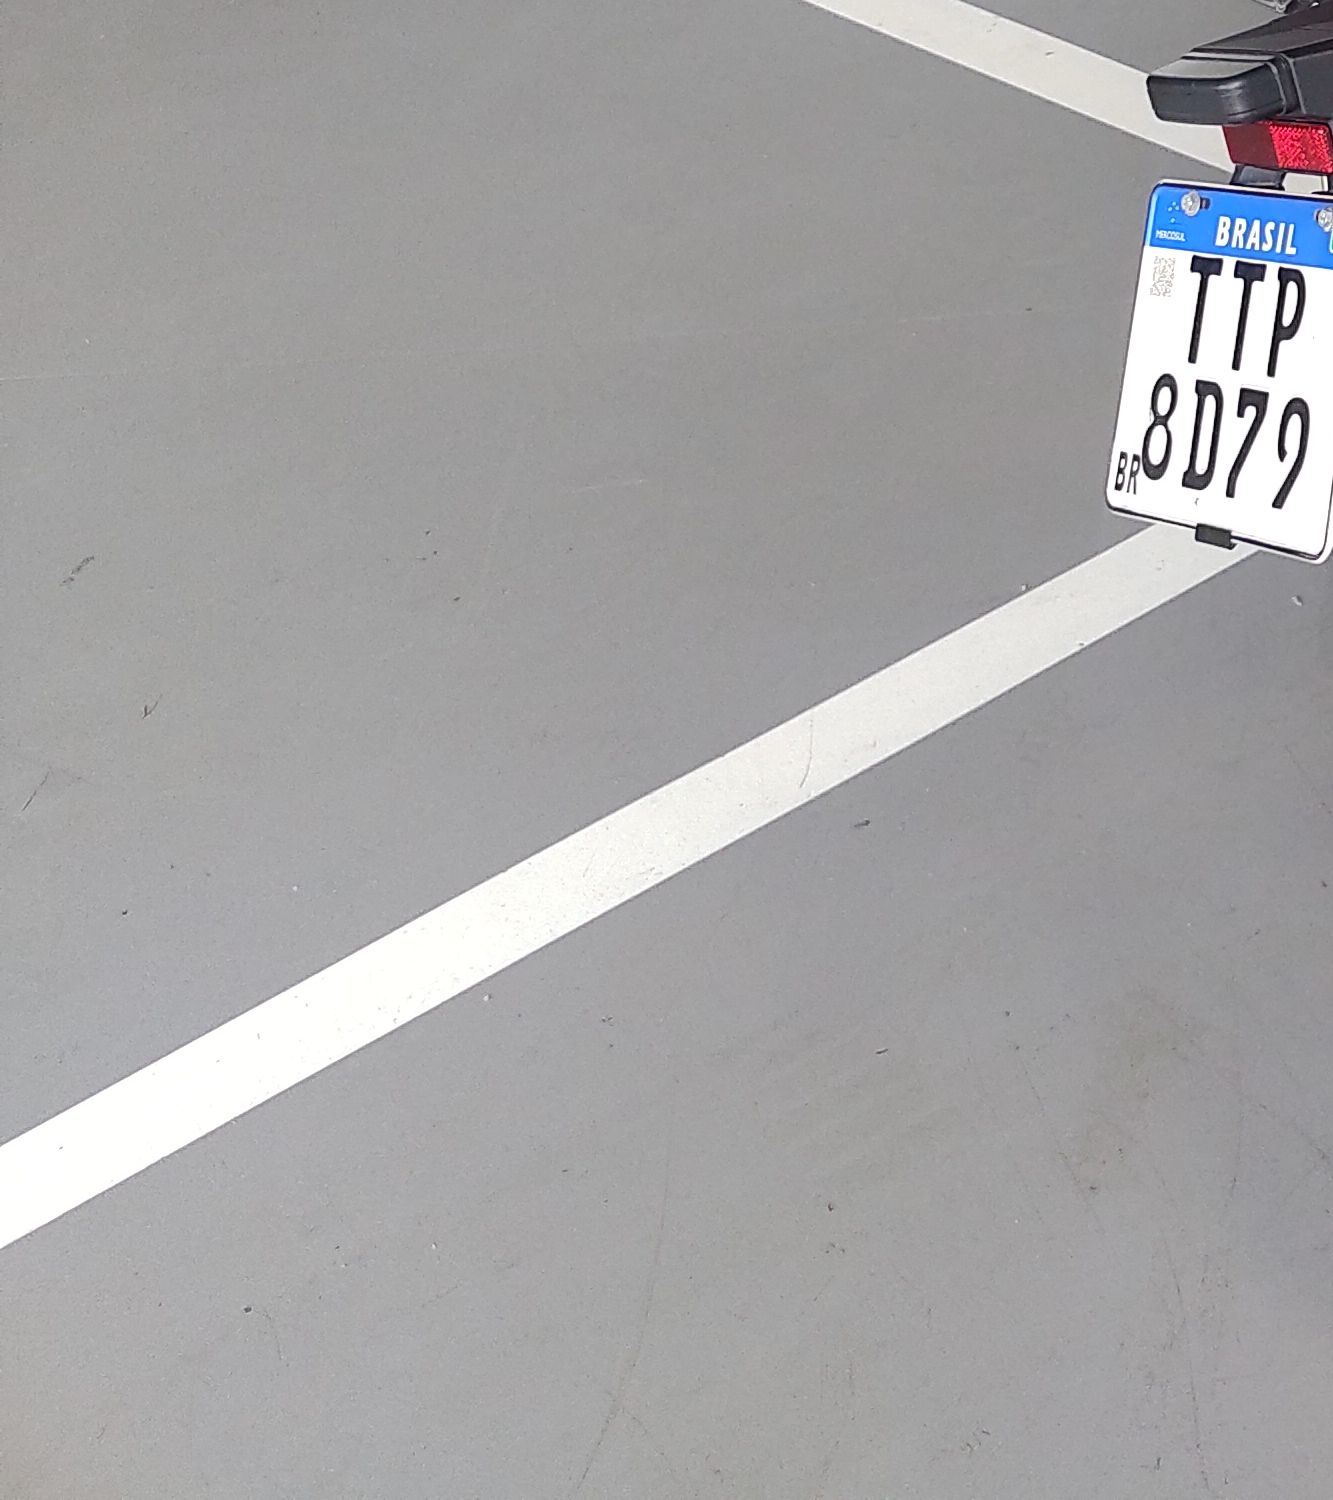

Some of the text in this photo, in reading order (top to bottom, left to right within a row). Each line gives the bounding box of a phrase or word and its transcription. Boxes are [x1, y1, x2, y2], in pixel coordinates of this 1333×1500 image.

[1155, 229, 1187, 243] MERCOSUL
[1215, 215, 1298, 256] BRASIL
[1188, 255, 1306, 377] TTP
[1142, 373, 1310, 509] 8D79
[1114, 451, 1141, 494] BR
